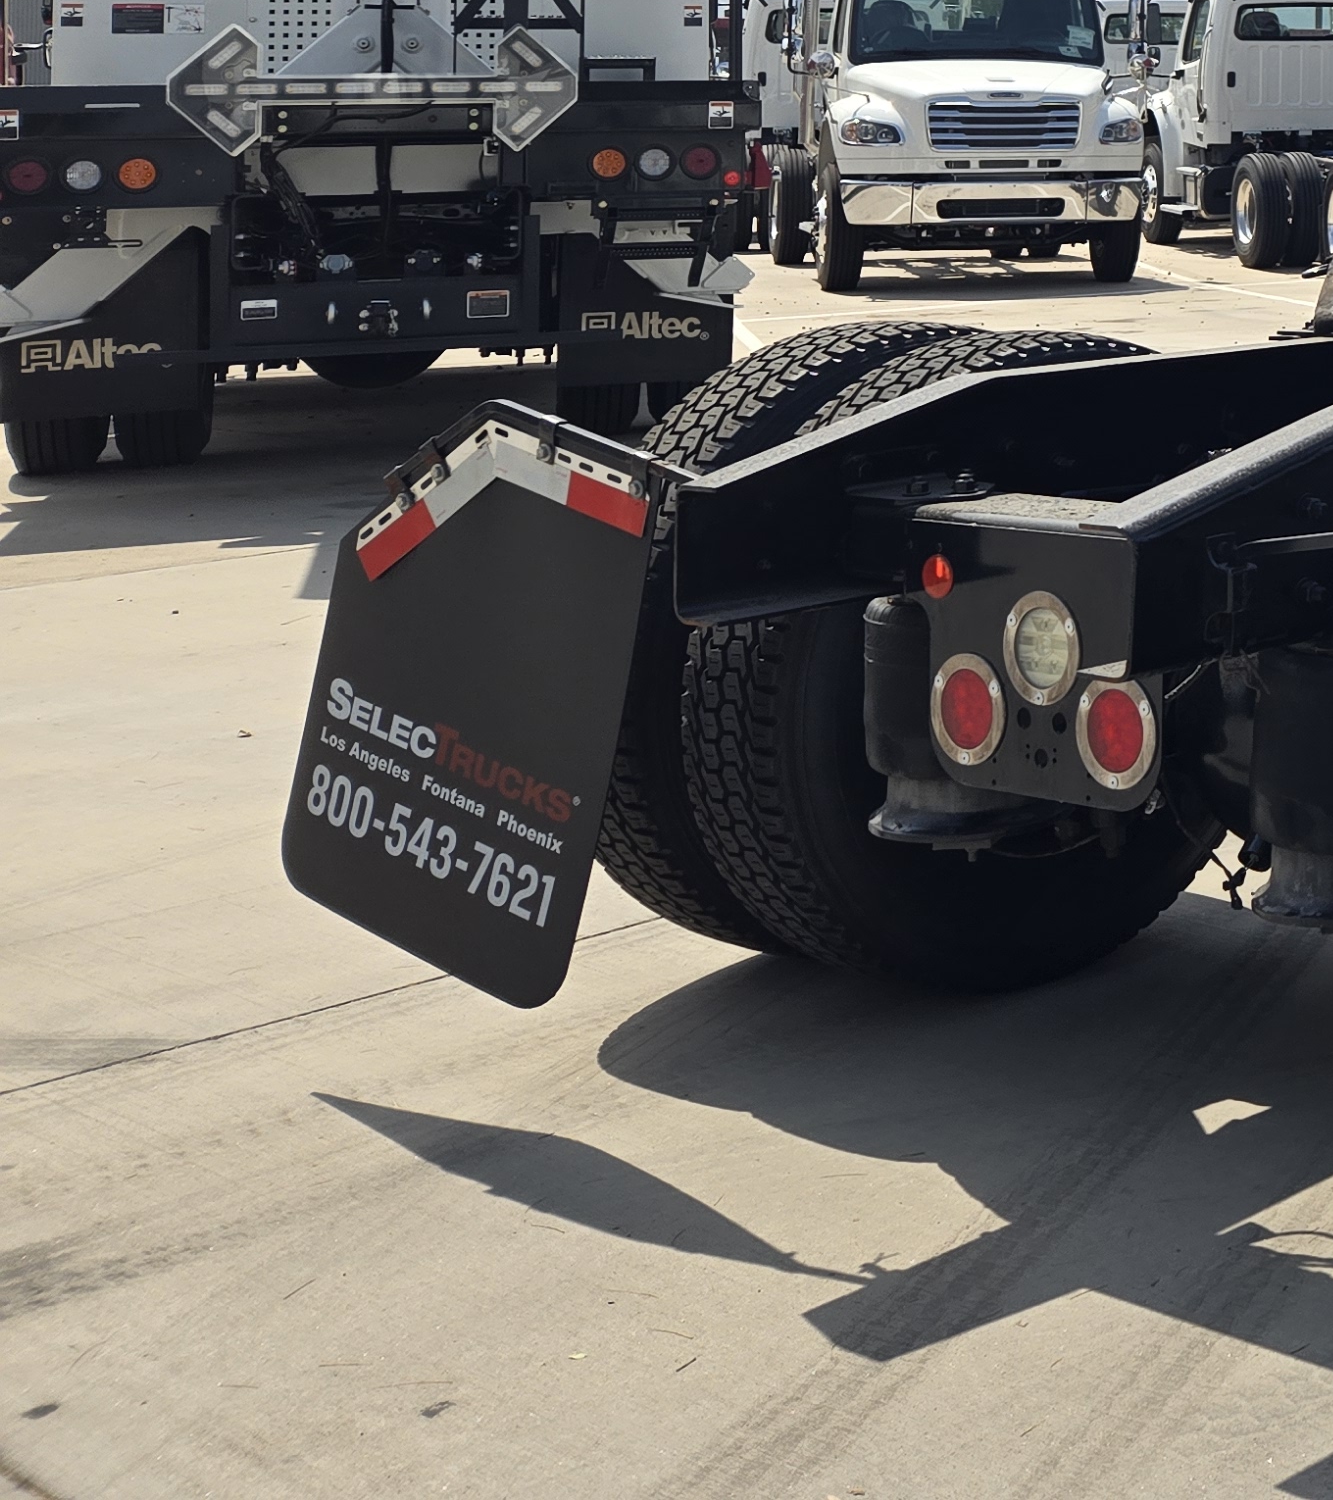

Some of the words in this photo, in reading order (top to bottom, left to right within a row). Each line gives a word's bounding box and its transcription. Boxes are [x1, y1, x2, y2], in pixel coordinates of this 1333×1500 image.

[620, 311, 701, 339] Altec
[307, 765, 556, 928] 800-543-7621
[321, 727, 346, 752] Los
[349, 742, 410, 782] Angeles
[422, 775, 486, 818] Fontana
[497, 810, 564, 854] Phoenix
